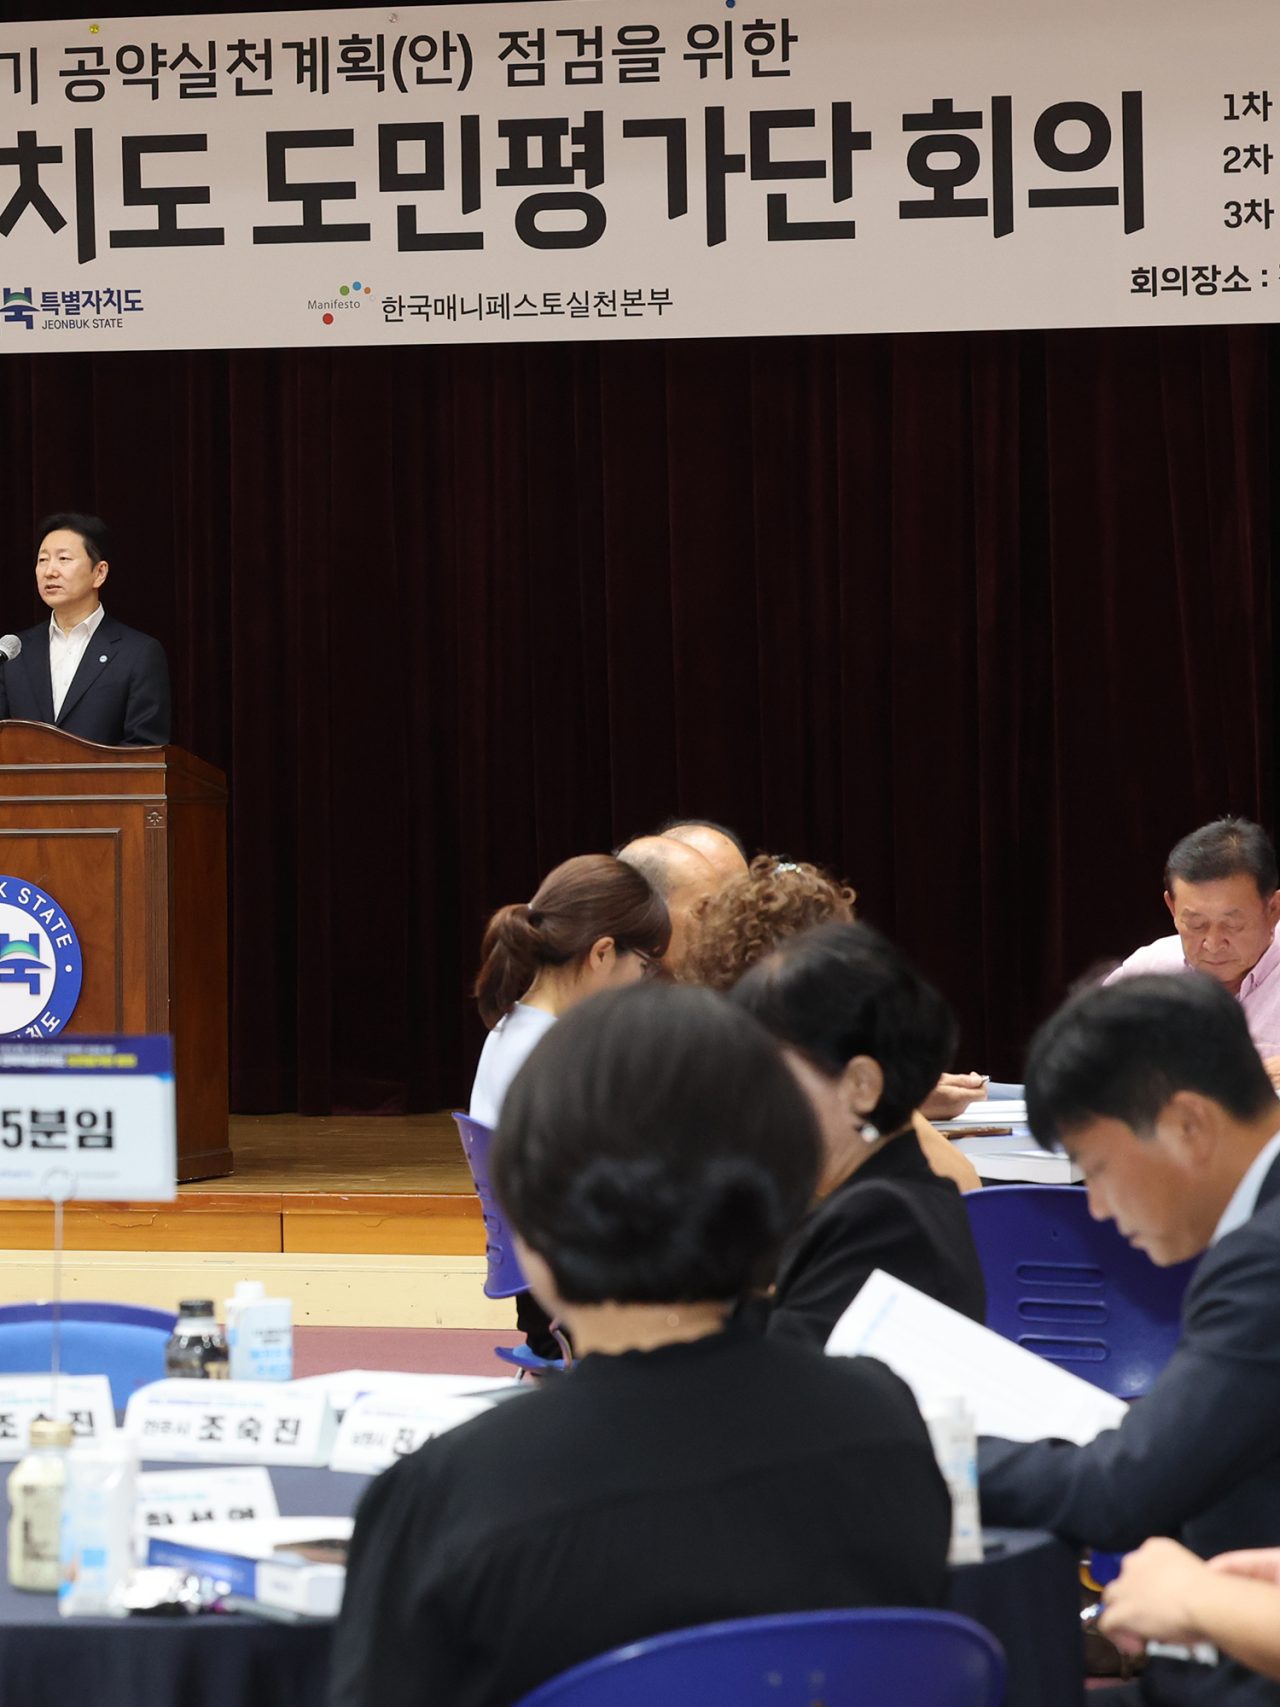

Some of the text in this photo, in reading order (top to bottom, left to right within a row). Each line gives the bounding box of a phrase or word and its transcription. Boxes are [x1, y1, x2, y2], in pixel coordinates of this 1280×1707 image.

[58, 31, 474, 103] 공약실천계획(안)
[497, 24, 667, 88] 점검을
[682, 17, 799, 81] 위한
[1223, 90, 1273, 123] 1차
[252, 101, 872, 253] 도민평가단
[898, 90, 1145, 239] 회의
[1223, 143, 1274, 175] 2차
[1223, 198, 1275, 230] 3차
[1130, 264, 1252, 298] 회의장소
[40, 287, 144, 316] 특별자치도
[307, 298, 361, 310] Manifesto
[381, 287, 674, 323] 한국매니페스토실천본부
[41, 317, 124, 330] JEONBUK STATE
[17, 887, 73, 949] STATE
[0, 1108, 115, 1151] 5분임
